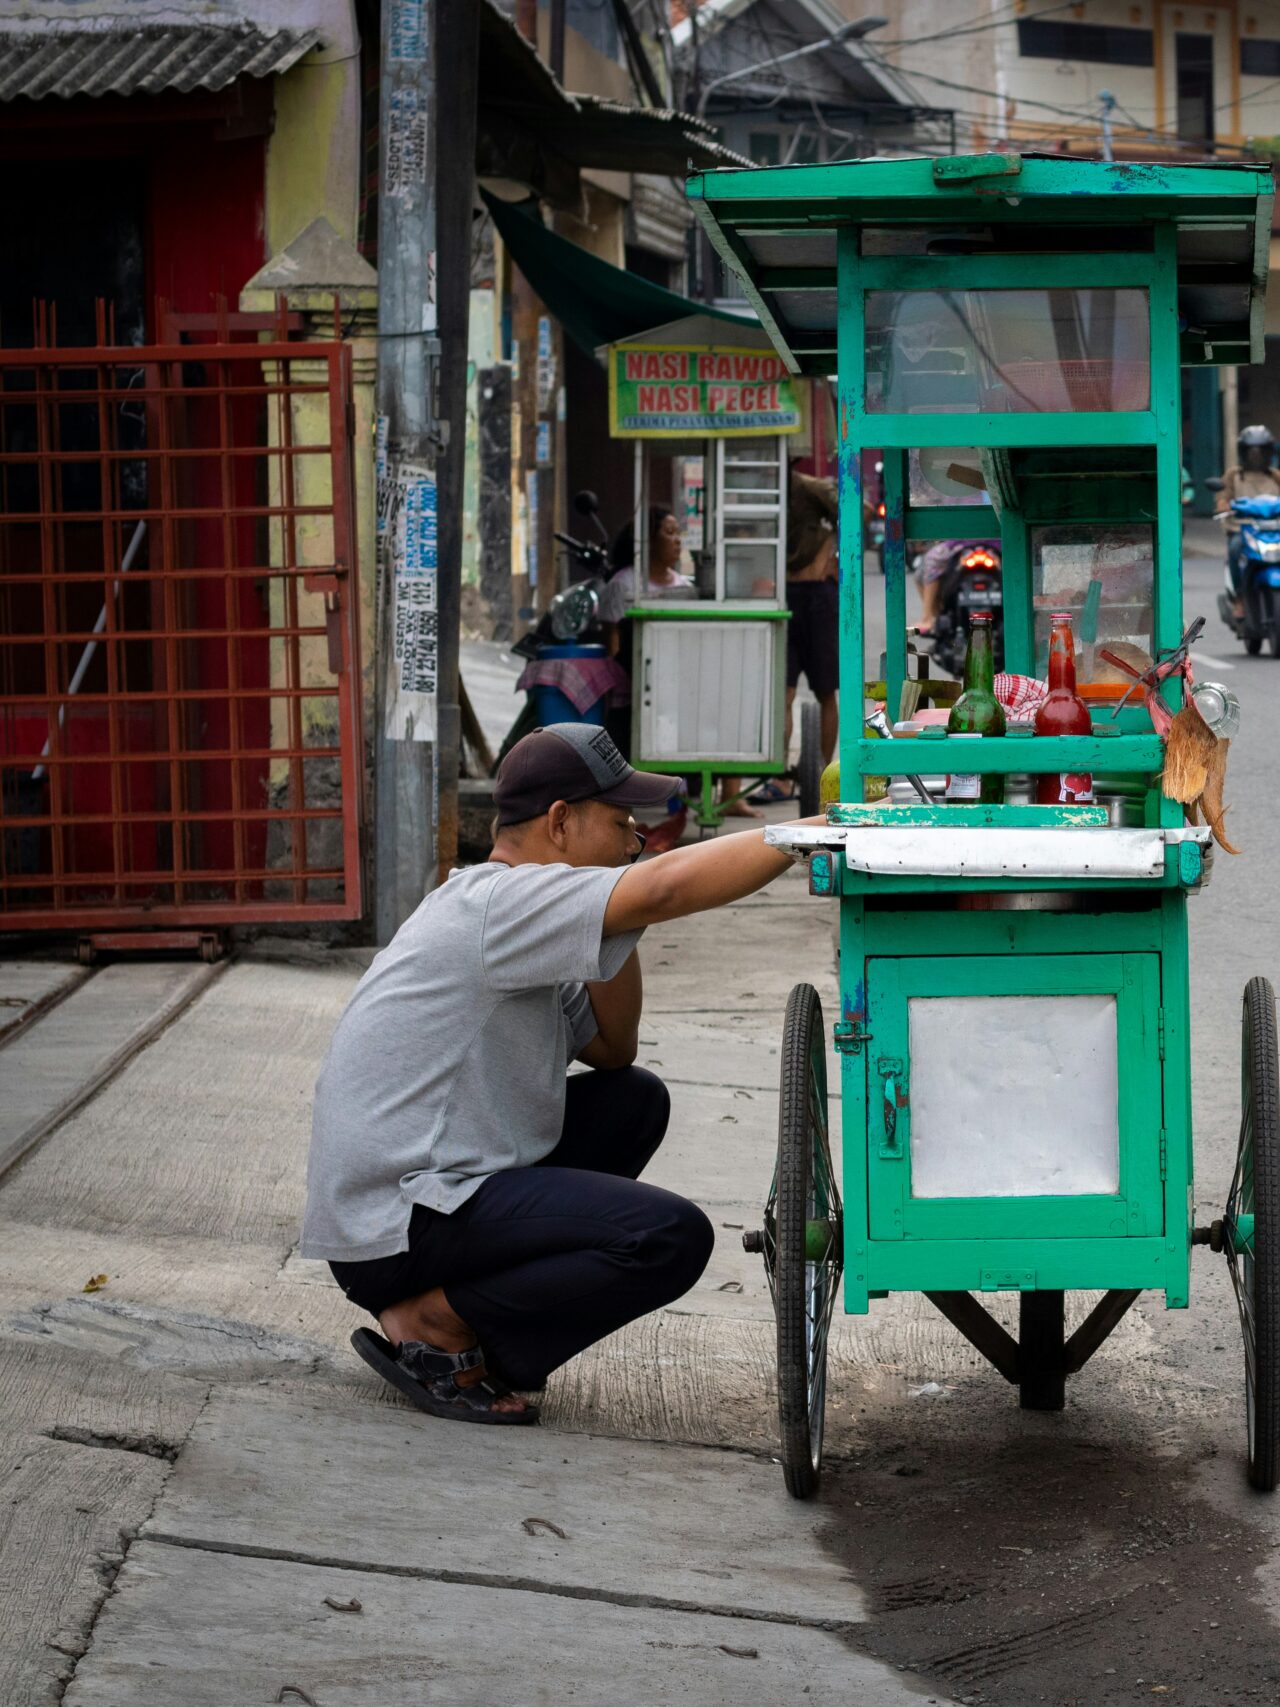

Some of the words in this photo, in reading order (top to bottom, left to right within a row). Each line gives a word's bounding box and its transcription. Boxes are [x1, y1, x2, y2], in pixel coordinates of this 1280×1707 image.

[387, 138, 401, 180] SEDOT
[625, 351, 689, 382] NASI
[697, 353, 792, 383] RAWO
[638, 384, 700, 414] NASI
[707, 384, 782, 414] PECEL
[407, 487, 416, 511] WC
[419, 487, 438, 513] 2000
[406, 516, 416, 569] SEDOT
[419, 542, 438, 569] 0857
[398, 581, 410, 601] WC
[405, 609, 417, 634] WC
[401, 638, 414, 692] SEDOT
[415, 674, 436, 694] 081
